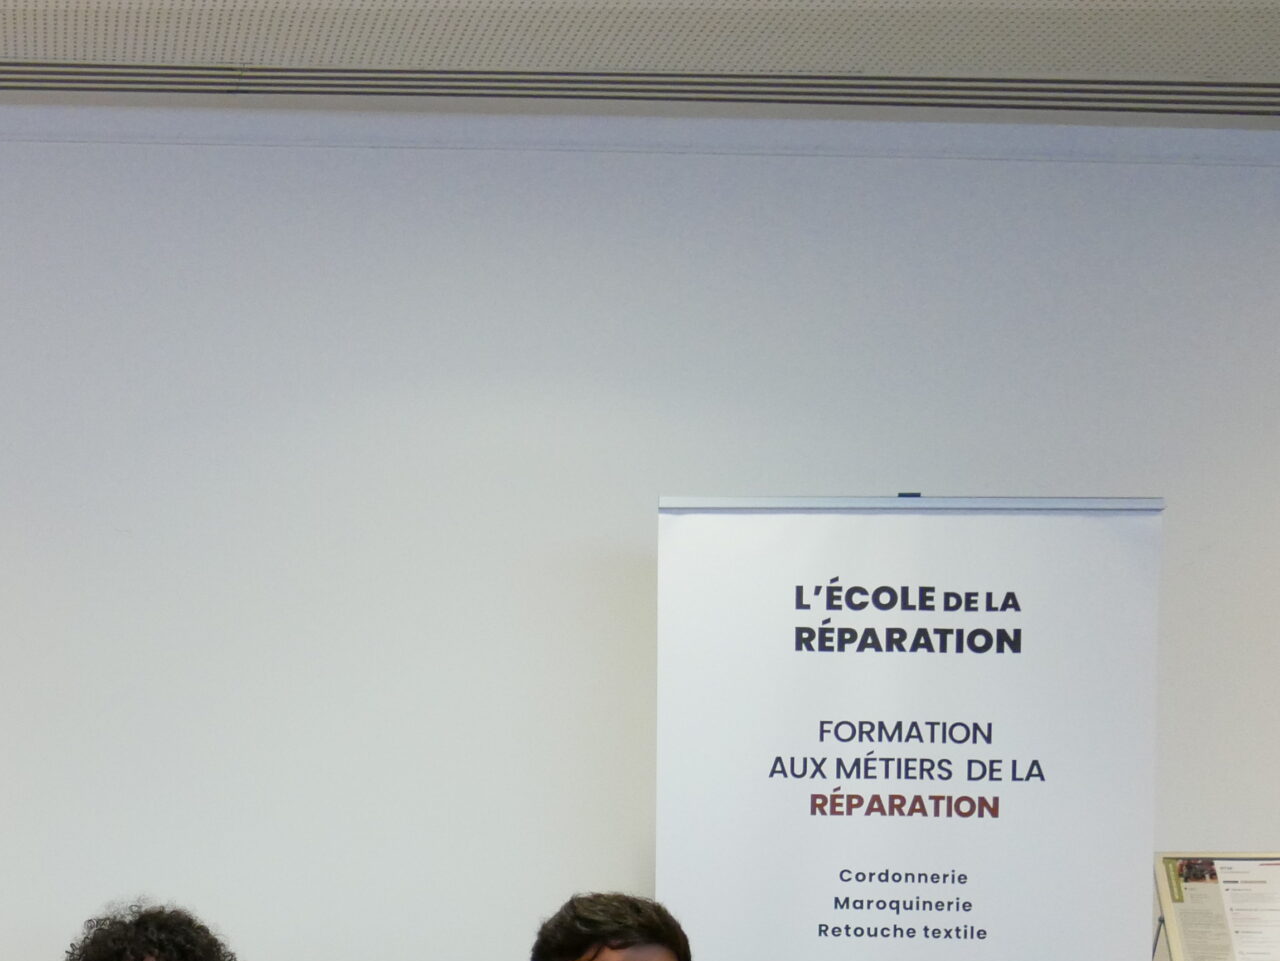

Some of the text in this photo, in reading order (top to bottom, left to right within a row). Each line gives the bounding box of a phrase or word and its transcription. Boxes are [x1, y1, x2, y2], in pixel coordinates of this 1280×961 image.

[795, 576, 1022, 612] L'ÉCOLE DE LA
[795, 618, 1022, 653] RÉPARATION
[819, 720, 993, 745] FORMATION
[768, 750, 1046, 782] AUX MÉTIERS DE LA
[810, 786, 1000, 818] RÉPARATION
[839, 868, 968, 885] Cordonnerie
[833, 896, 973, 915] Maroquinerie
[818, 923, 988, 940] Retouche textile
